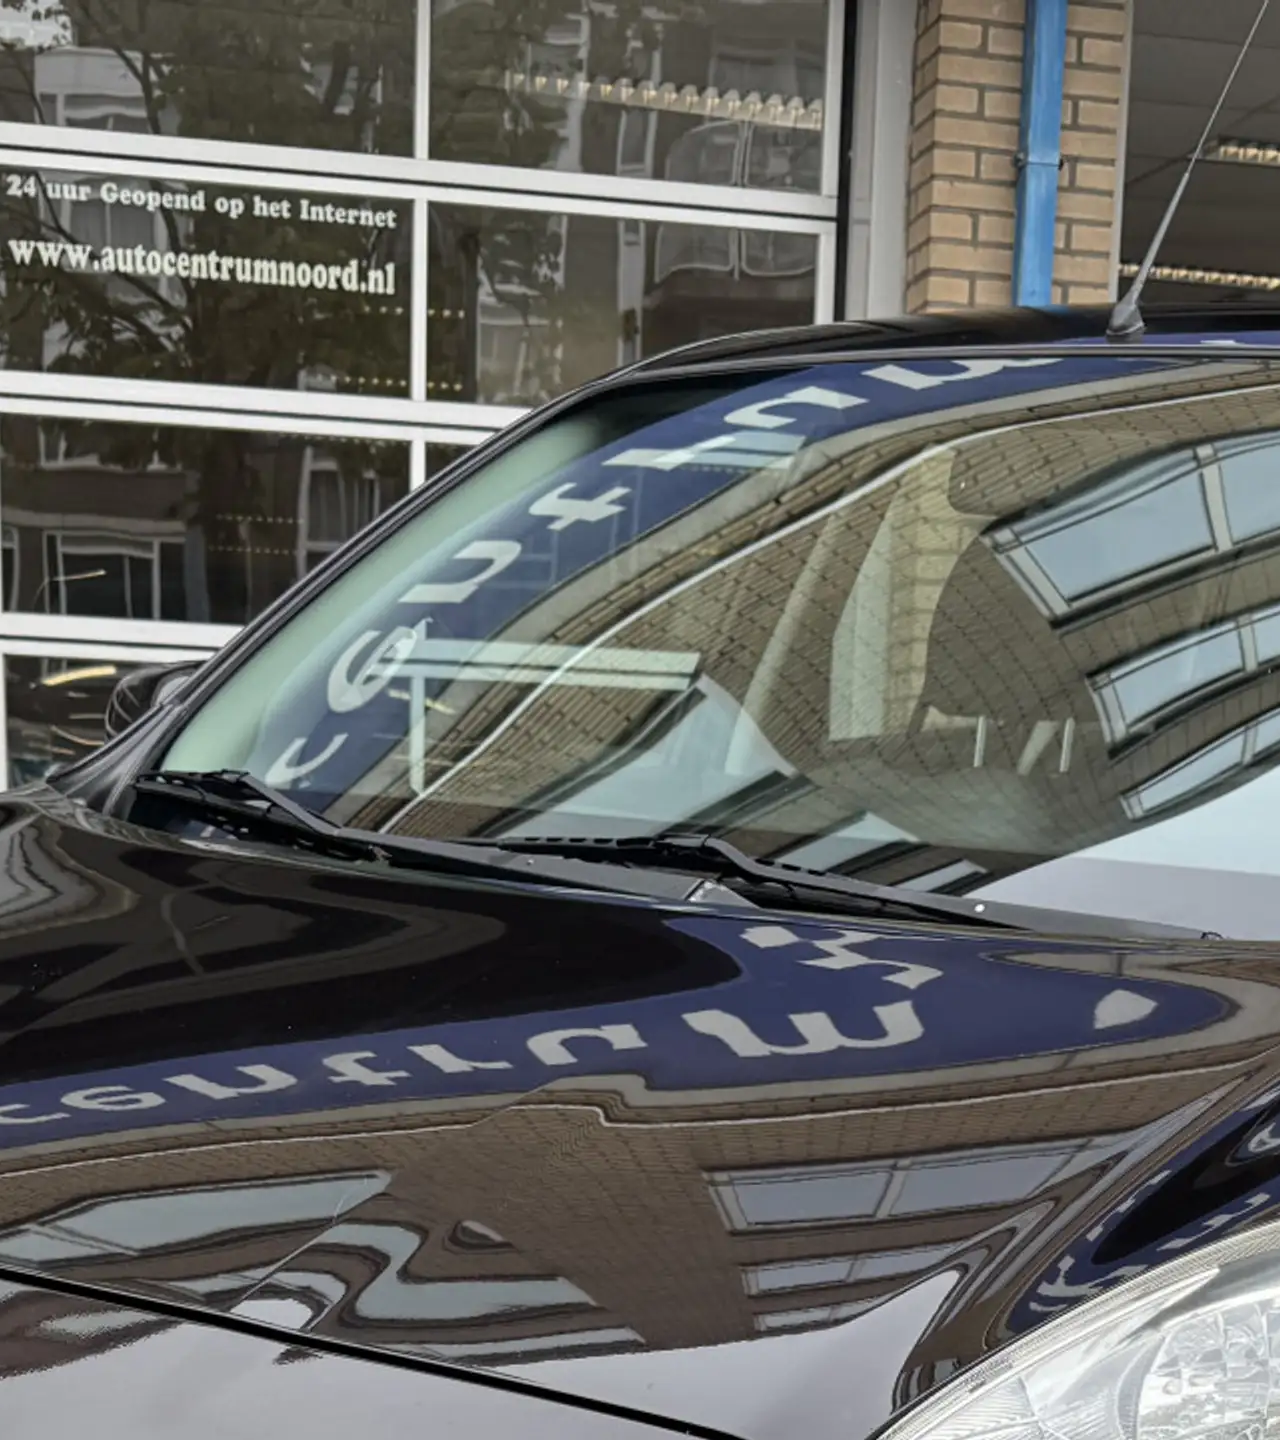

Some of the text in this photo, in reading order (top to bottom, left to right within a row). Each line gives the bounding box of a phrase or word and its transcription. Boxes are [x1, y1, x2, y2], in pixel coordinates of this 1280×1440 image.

[6, 174, 397, 229] 24 uur Geopend op het Internet
[8, 239, 396, 295] www.autocentrumnoord.nl
